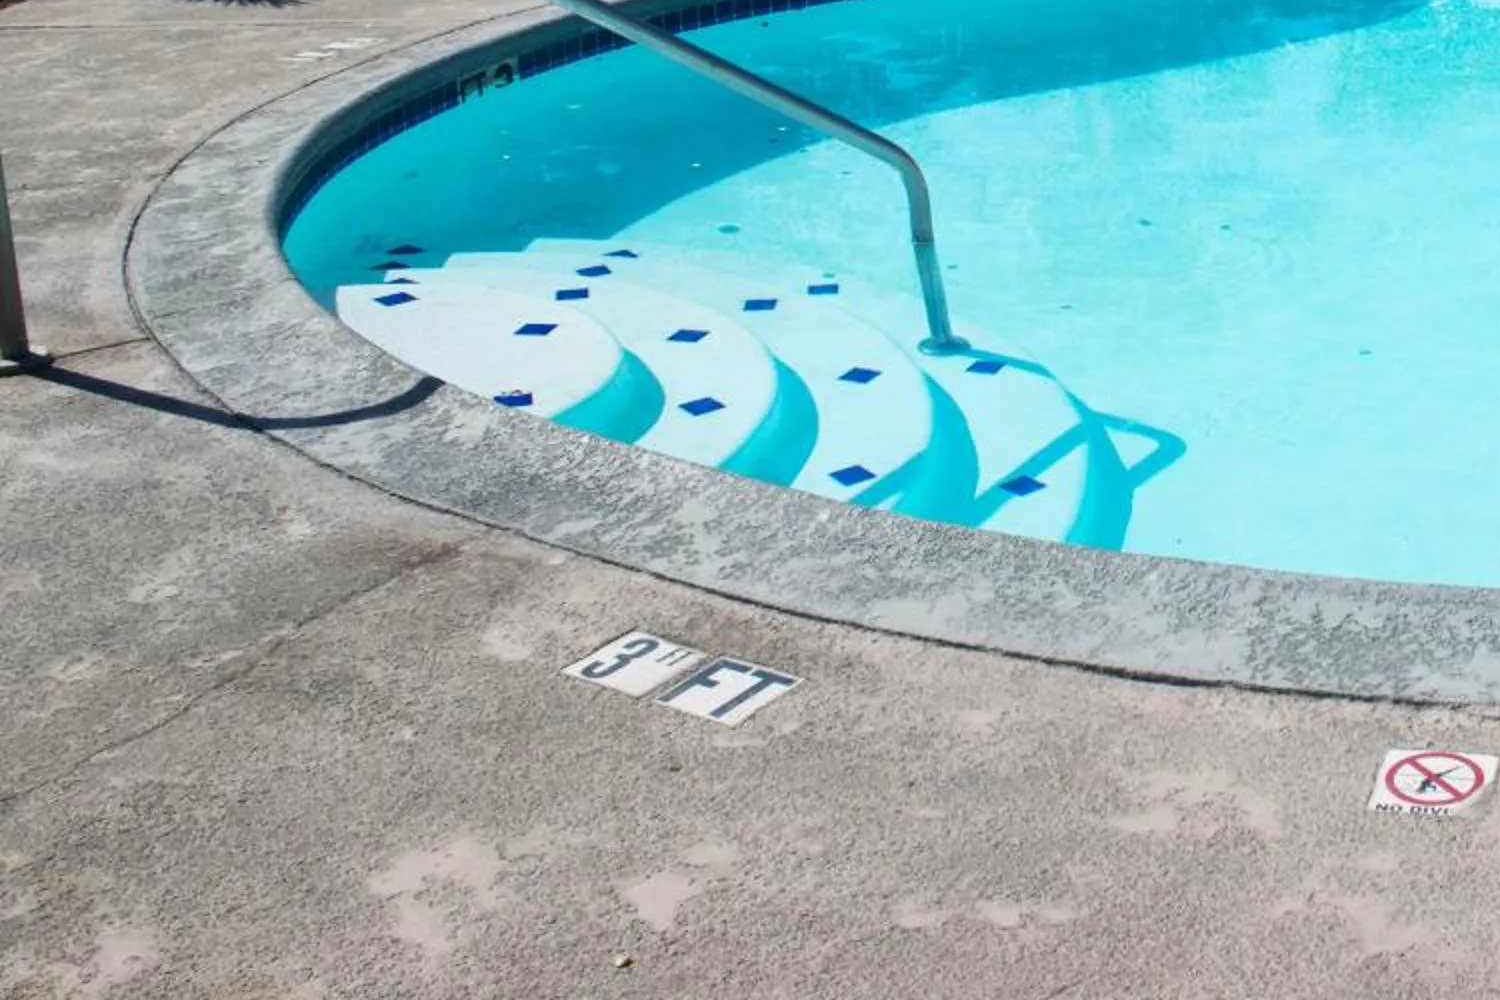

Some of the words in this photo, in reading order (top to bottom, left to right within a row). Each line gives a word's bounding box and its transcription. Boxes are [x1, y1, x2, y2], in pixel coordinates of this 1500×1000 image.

[580, 638, 660, 679] 3
[659, 657, 797, 718] FT
[1375, 803, 1403, 813] NO
